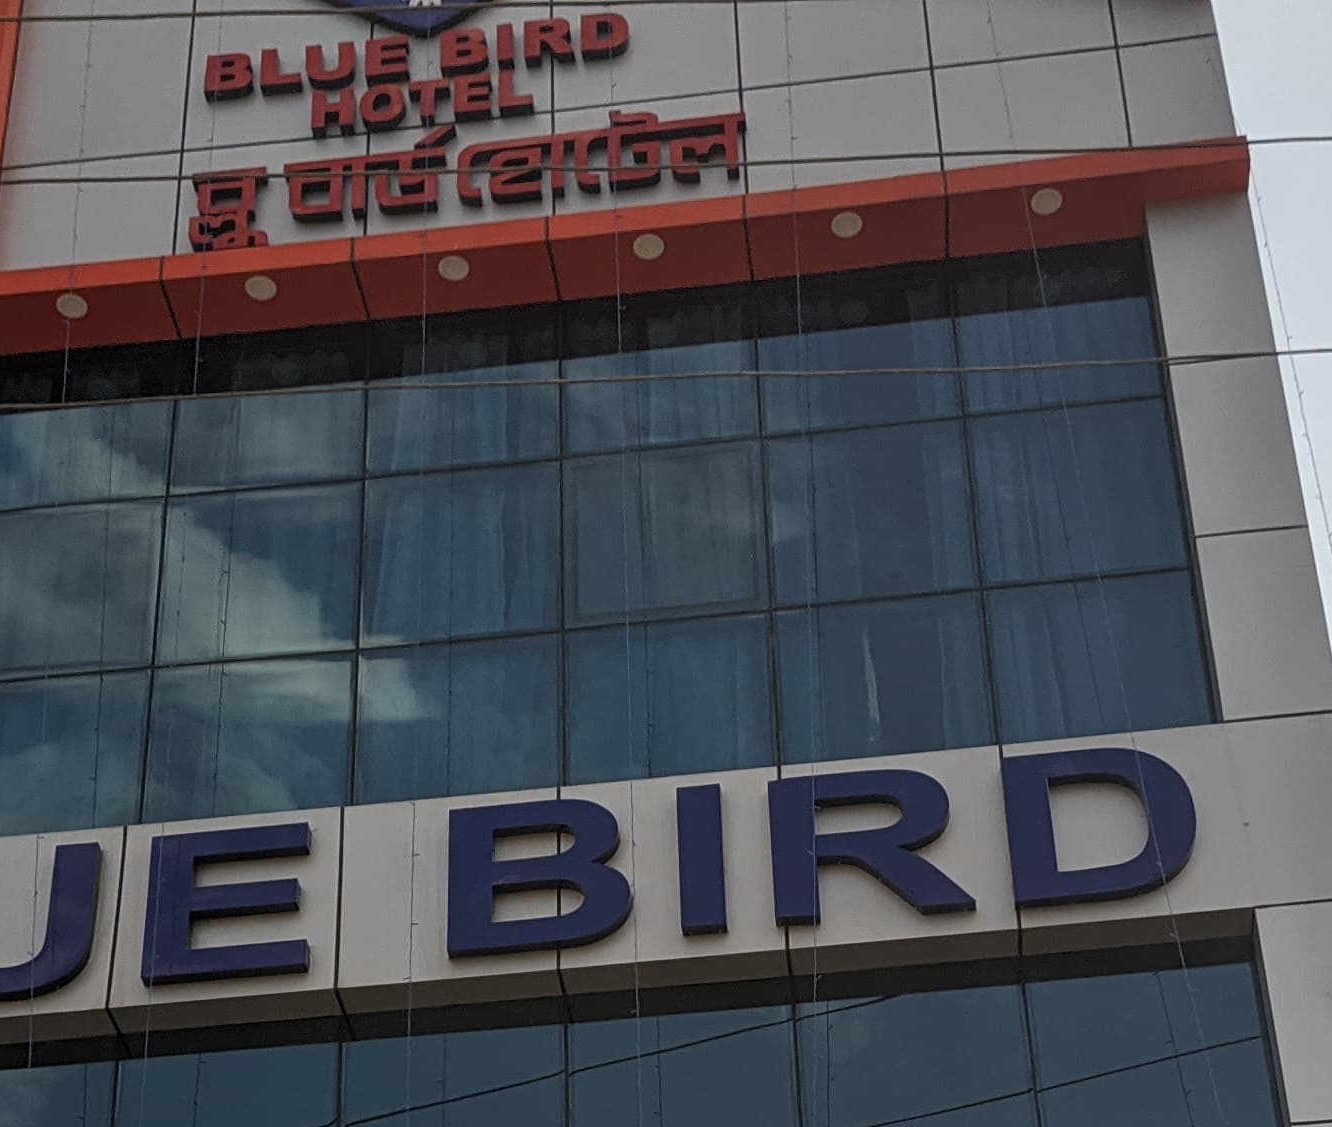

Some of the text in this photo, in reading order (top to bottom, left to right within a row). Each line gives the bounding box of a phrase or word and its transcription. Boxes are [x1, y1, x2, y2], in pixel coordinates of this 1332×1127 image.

[204, 13, 630, 101] BLUE BIRD
[310, 68, 534, 137] HOTEL
[457, 110, 747, 208] হোটেল
[447, 746, 1199, 961] BIRD
